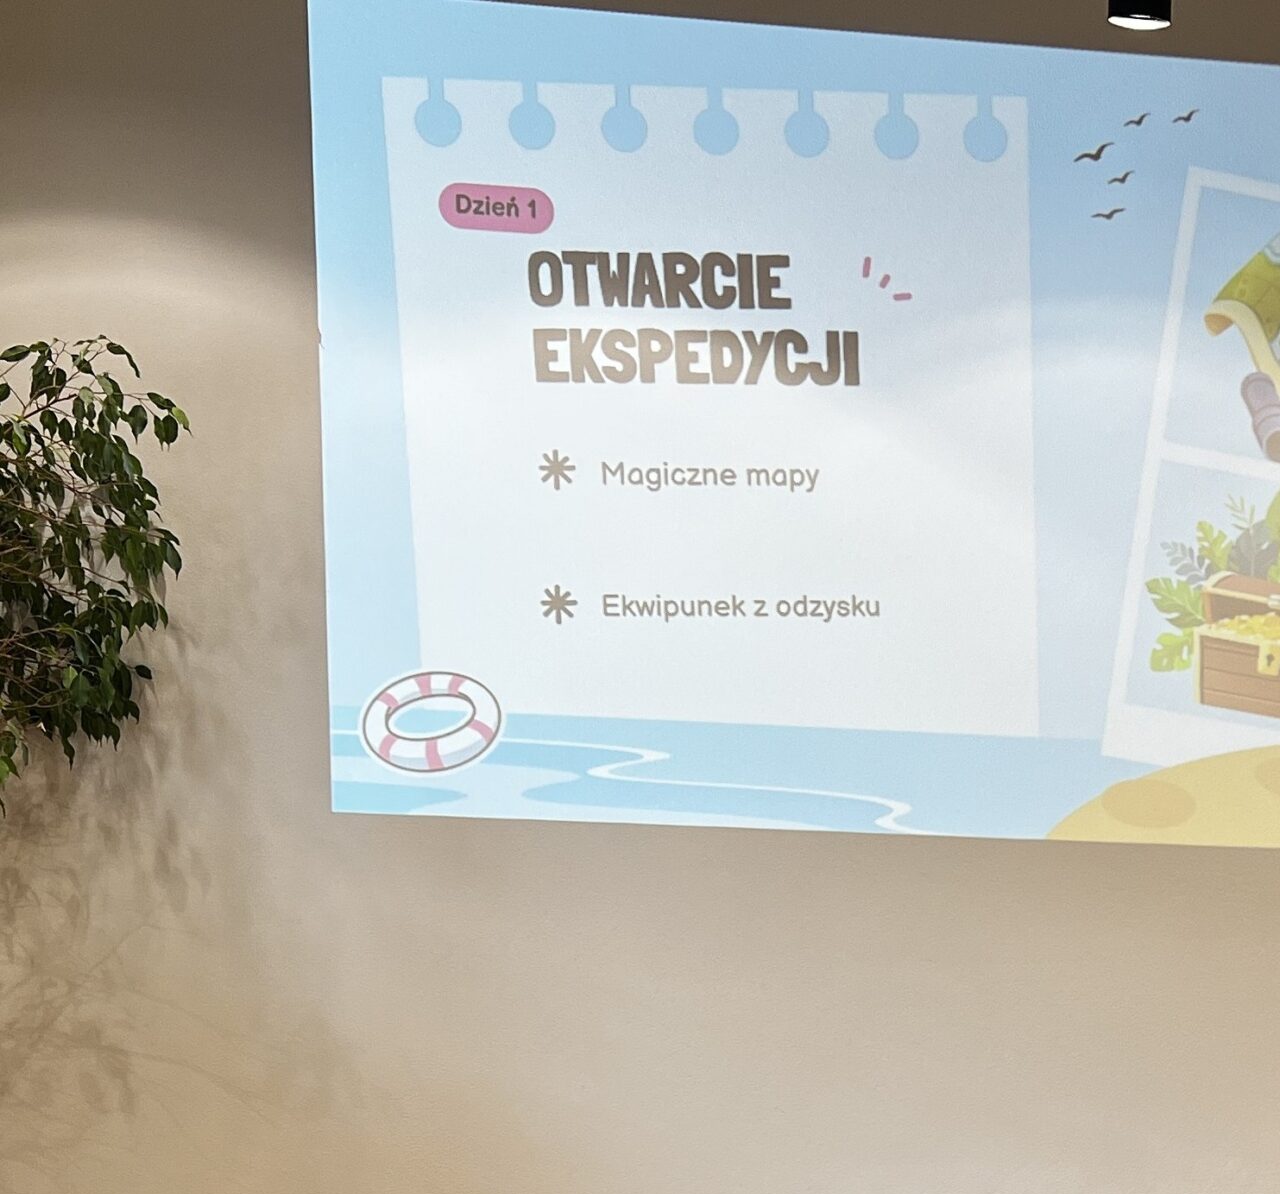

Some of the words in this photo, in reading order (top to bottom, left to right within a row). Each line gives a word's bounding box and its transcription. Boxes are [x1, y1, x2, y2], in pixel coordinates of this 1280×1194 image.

[455, 194, 520, 218] Dzień
[527, 199, 538, 219] 1
[527, 250, 792, 310] OTWARCIE
[532, 328, 861, 386] EKSPEDYCJI
[601, 461, 738, 492] Magiczne
[746, 466, 820, 493] mapy
[602, 594, 746, 622] Ekwipunek
[753, 600, 769, 617] z
[776, 594, 881, 622] odzysku
